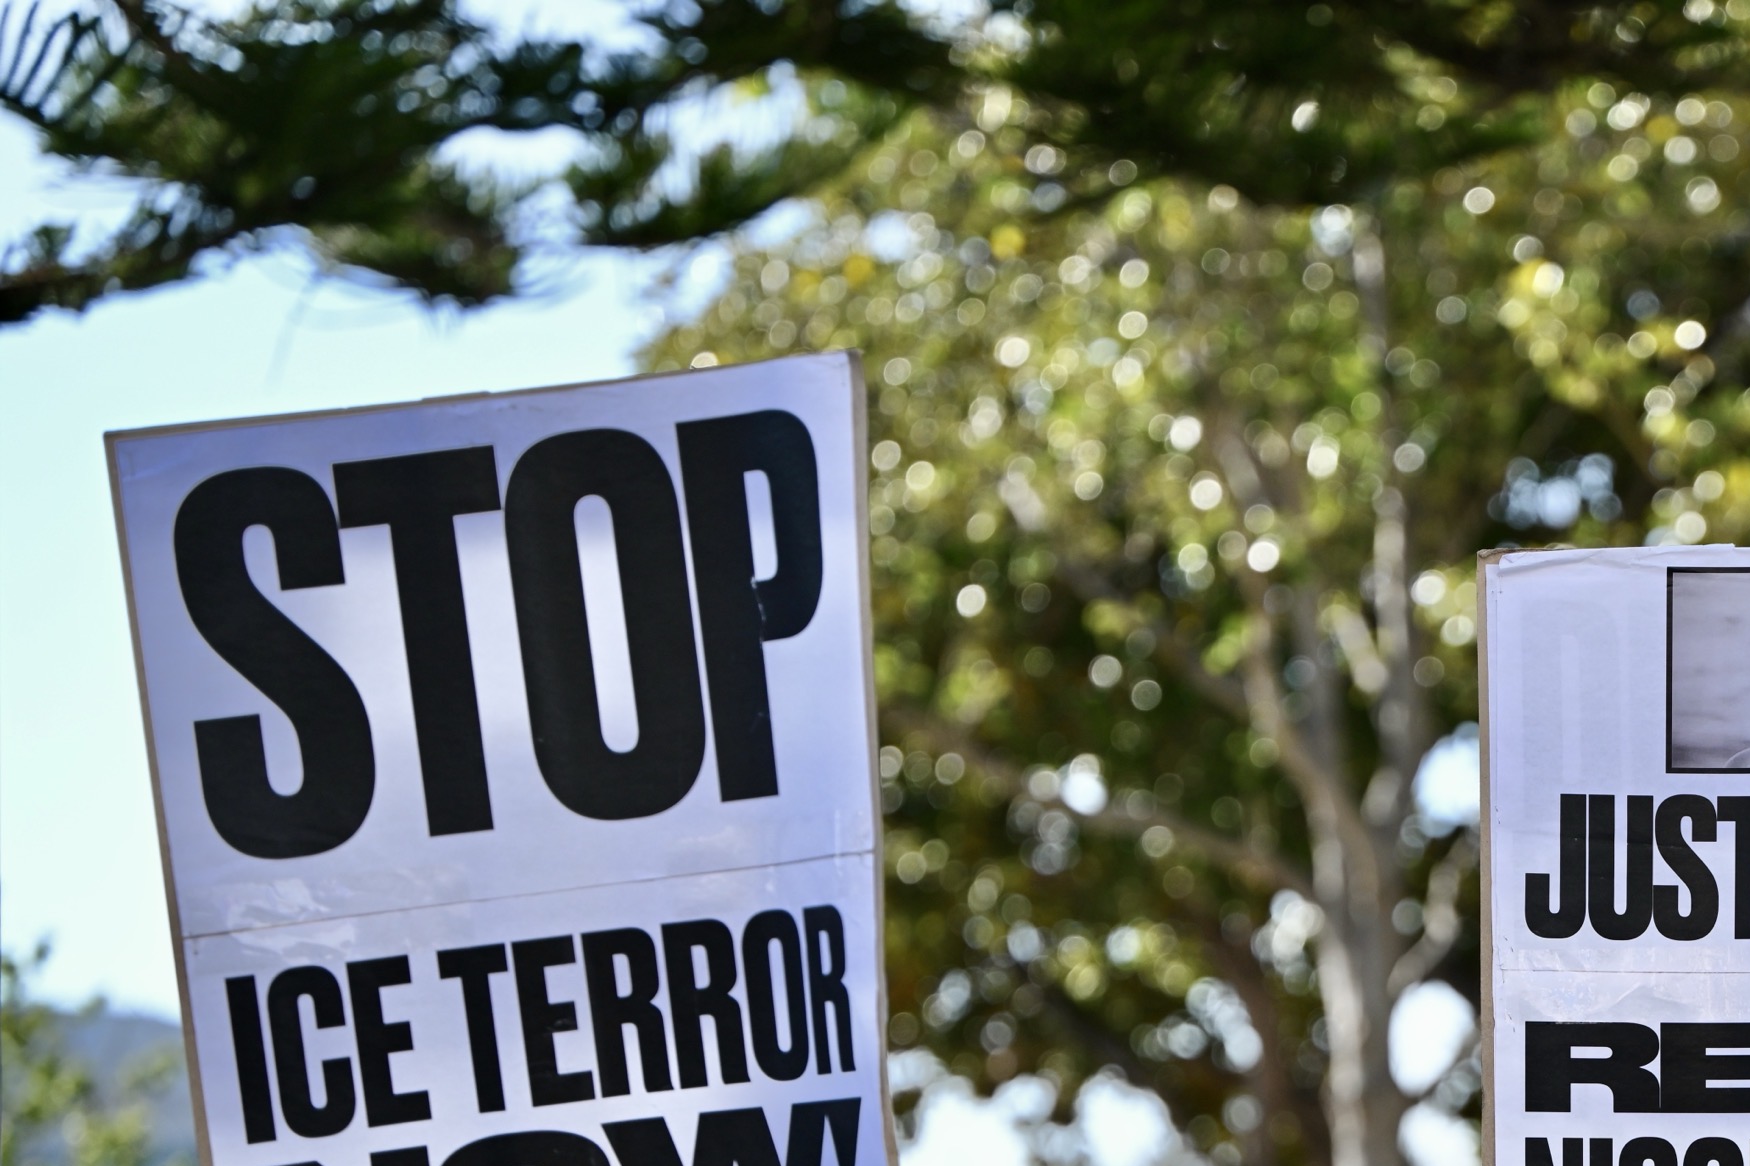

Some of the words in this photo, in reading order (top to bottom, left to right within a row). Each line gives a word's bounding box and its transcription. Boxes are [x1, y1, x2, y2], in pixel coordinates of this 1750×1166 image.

[174, 410, 822, 859] STOP
[225, 955, 431, 1144] ICE
[437, 905, 856, 1113] TERROR
